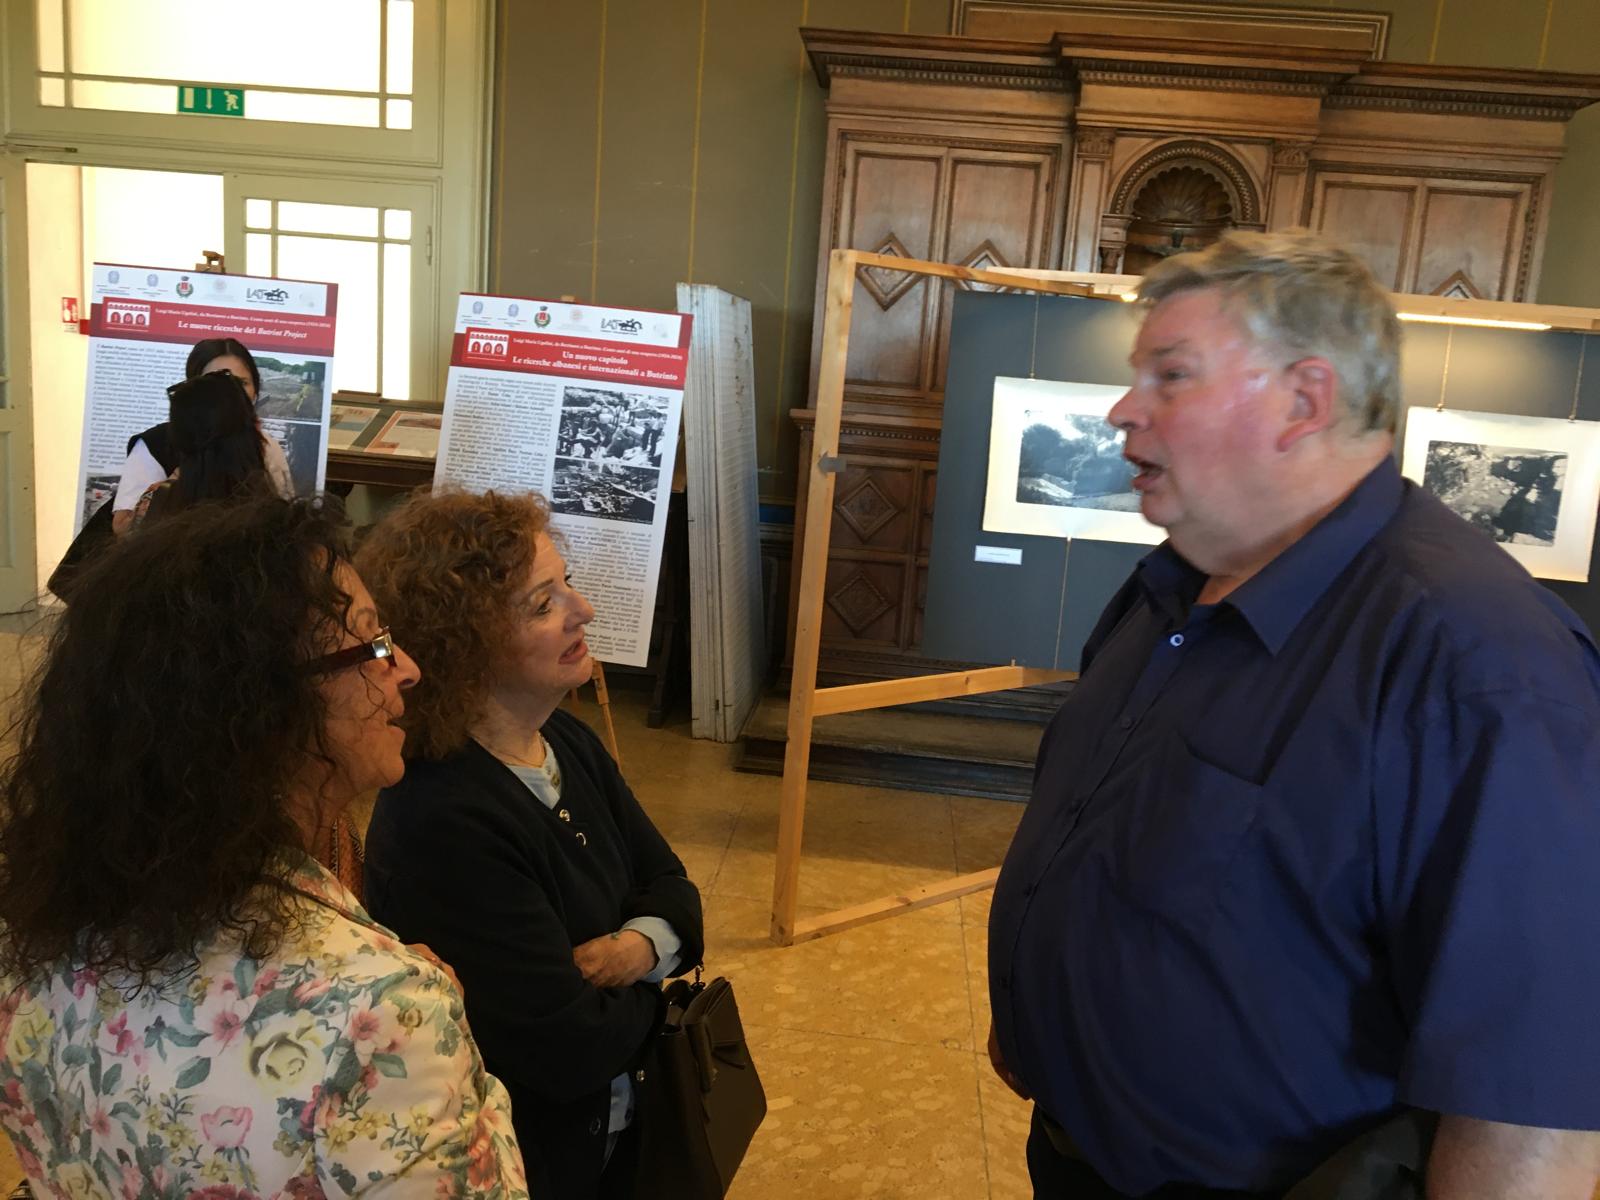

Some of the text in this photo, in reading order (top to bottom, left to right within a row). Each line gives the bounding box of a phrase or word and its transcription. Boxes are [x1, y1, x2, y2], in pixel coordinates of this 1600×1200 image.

[178, 320, 188, 328] Le
[189, 322, 212, 330] nuove
[212, 324, 243, 333] ricerche
[244, 326, 256, 334] del
[283, 330, 308, 340] Project
[562, 351, 574, 359] Un
[598, 356, 628, 365] capitolo
[523, 358, 552, 367] ricerche
[552, 360, 582, 370] albanesi
[588, 364, 640, 376] internazionali
[646, 370, 678, 381] Butrinto
